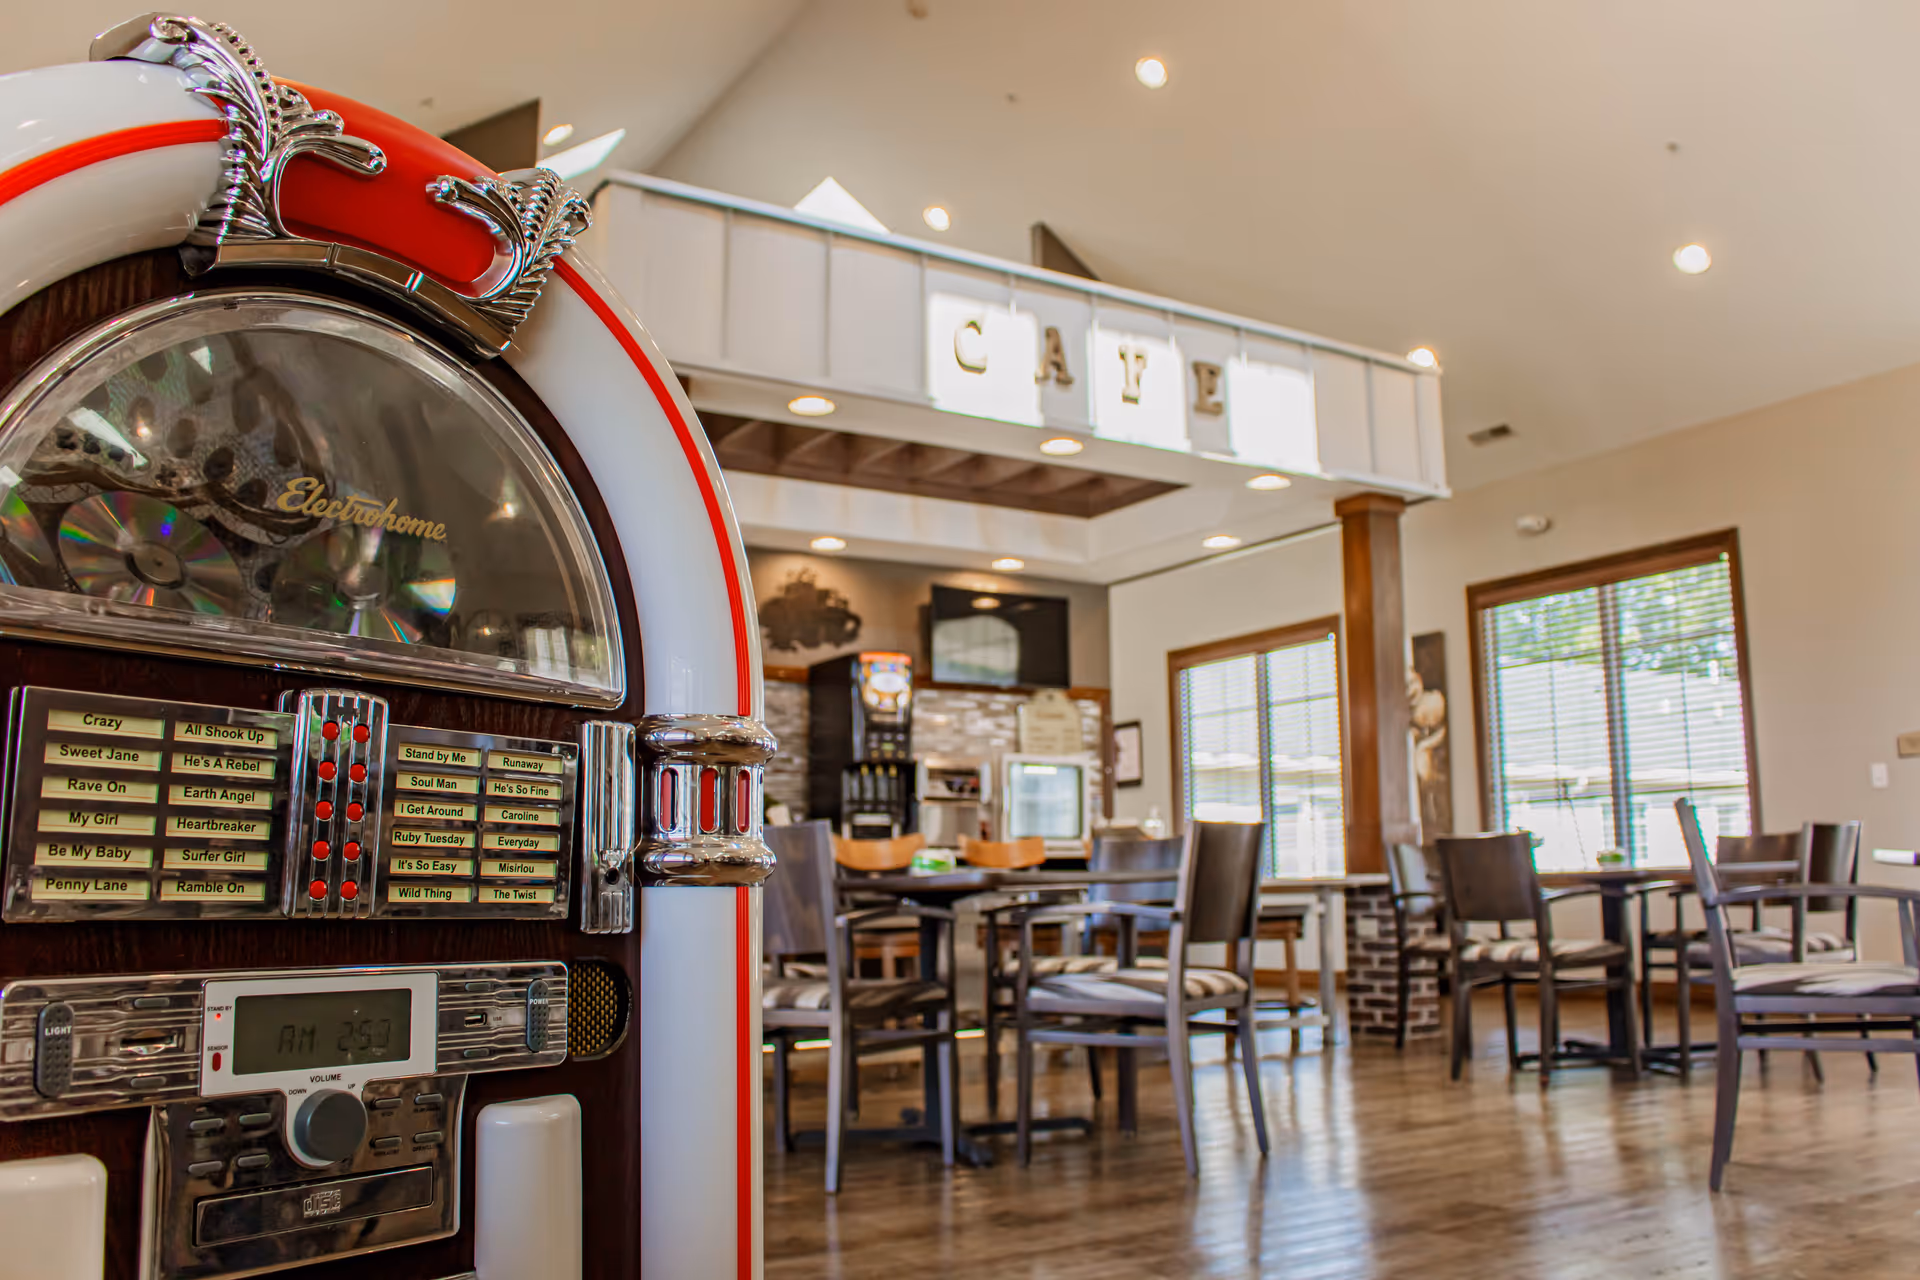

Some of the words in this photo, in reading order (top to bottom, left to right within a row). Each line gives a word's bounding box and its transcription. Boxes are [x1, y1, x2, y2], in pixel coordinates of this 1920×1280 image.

[276, 476, 447, 540] Electrohome
[83, 713, 122, 730] Crazy
[184, 724, 201, 736] All
[204, 726, 244, 740] Shook
[247, 730, 264, 742] Up
[60, 744, 103, 759] Sweet
[106, 748, 140, 762] Jane
[405, 748, 434, 760] Stand
[437, 748, 450, 763] by
[452, 751, 466, 763] Me
[184, 754, 210, 768] He's
[213, 758, 222, 769] A
[226, 759, 260, 772] Rebel
[502, 758, 544, 772] Runaway
[68, 778, 102, 792] Rave
[107, 781, 126, 794] On
[410, 776, 434, 788] Soul
[437, 778, 457, 790] Man
[494, 783, 513, 794] He's
[516, 784, 528, 795] So
[530, 785, 549, 796] Fine
[184, 786, 216, 800] Earth
[220, 789, 255, 804] Angel
[400, 804, 404, 814] I
[406, 804, 424, 815] Get
[427, 805, 464, 817] Around
[502, 810, 539, 822] Caroline
[69, 812, 89, 826] My
[94, 812, 118, 826] Girl
[176, 818, 256, 833] Heartbreaker
[394, 831, 421, 845] Ruby
[424, 832, 465, 846] Tuesday
[498, 836, 539, 849] Everyday
[48, 844, 66, 856] Be
[72, 845, 91, 861] My
[96, 846, 132, 862] Baby
[182, 850, 221, 863] Surfer
[223, 850, 246, 863] Girl
[398, 860, 413, 871] It's
[416, 860, 430, 871] So
[432, 861, 456, 874] Easy
[498, 862, 534, 874] Misirlou
[45, 878, 90, 894] Penny
[94, 879, 128, 891] Lane
[176, 881, 224, 894] Ramble
[228, 882, 245, 894] On
[398, 888, 421, 898] Wild
[424, 888, 452, 901] Thing
[494, 890, 510, 900] The
[512, 890, 536, 900] Twist
[44, 1025, 72, 1036] LIGHT
[310, 1074, 342, 1082] VOLUME
